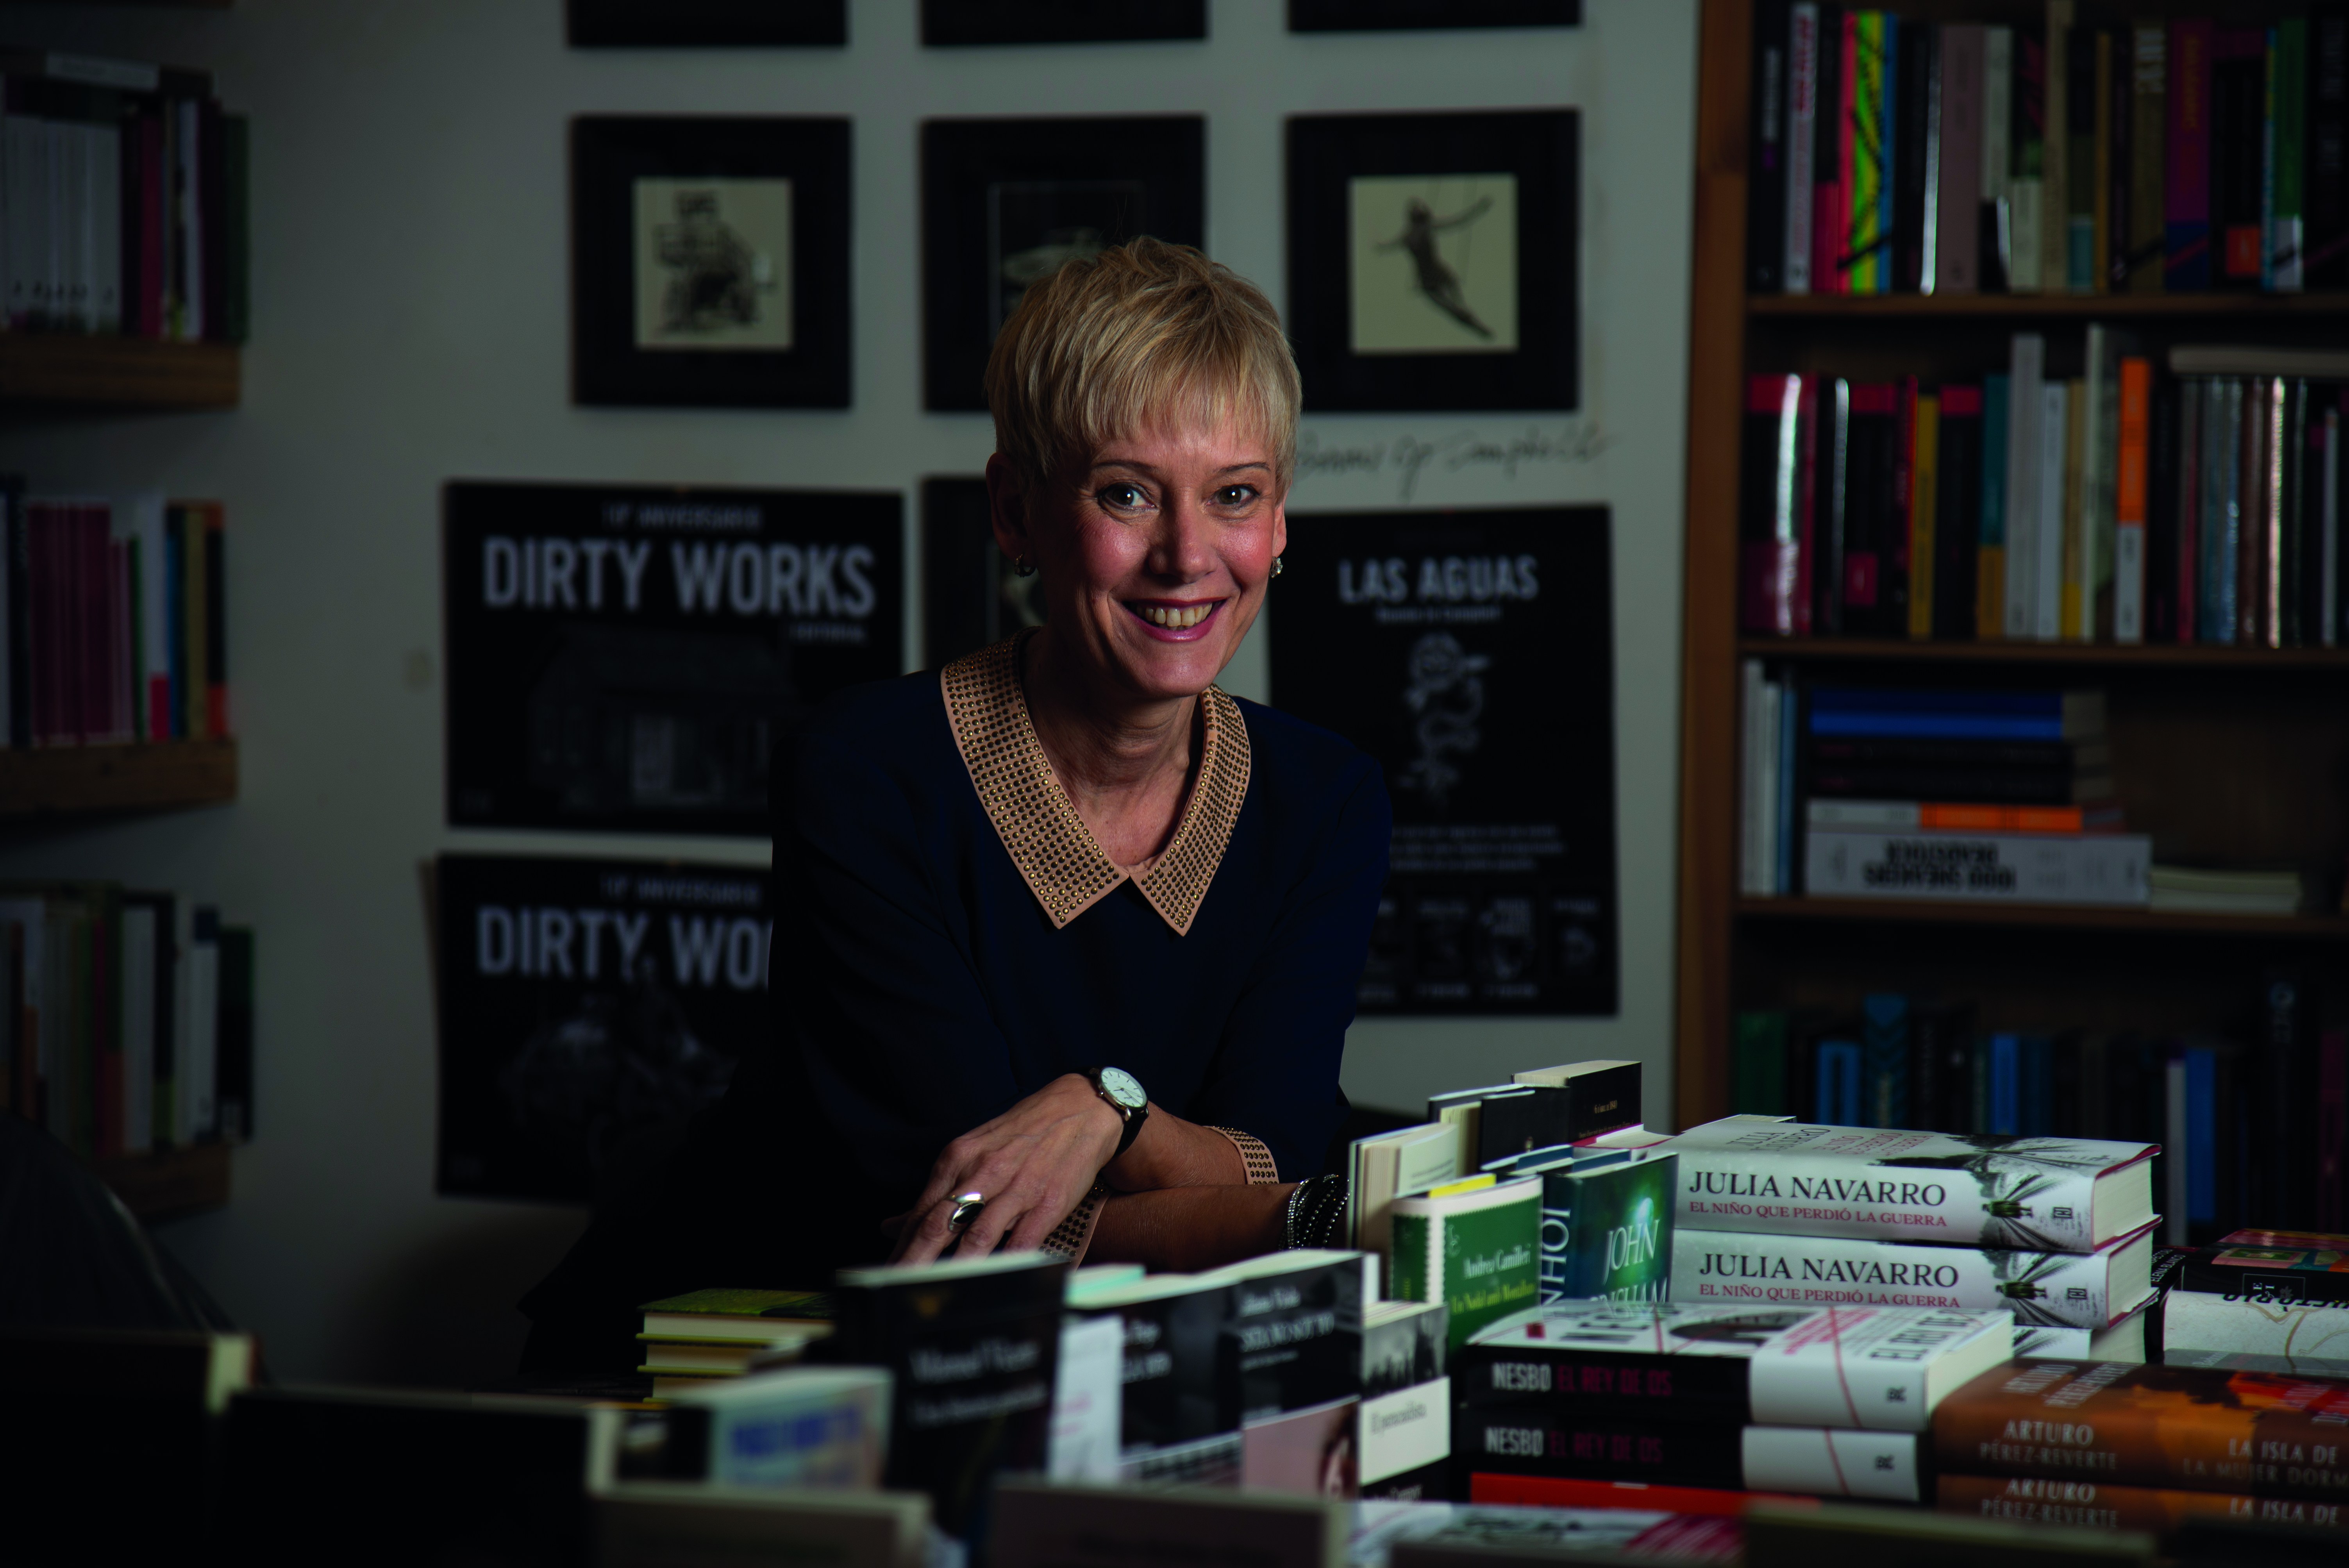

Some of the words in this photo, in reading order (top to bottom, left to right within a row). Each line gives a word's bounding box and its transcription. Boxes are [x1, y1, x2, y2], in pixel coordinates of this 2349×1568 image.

[481, 534, 653, 613] DIRTY
[669, 539, 880, 620] WORKS
[1337, 555, 1409, 605] LAS
[1416, 553, 1540, 603] AGUAS
[475, 904, 652, 985] DIRTY
[1689, 1171, 1783, 1198] JULIA
[1790, 1176, 1947, 1207] NAVARRO
[1689, 1201, 1707, 1213] EL
[1712, 1200, 1753, 1216] NIÑO
[1756, 1205, 1790, 1218] QUE
[1793, 1206, 1852, 1222] PERDIÓ
[1856, 1210, 1877, 1223] LA
[1881, 1212, 1947, 1227] GUERRA
[1463, 1253, 1495, 1280] Andrea
[1602, 1219, 1660, 1286] JOHN
[2160, 1254, 2186, 1269] BLANCO
[1700, 1252, 1794, 1280] JULIA
[1801, 1258, 1960, 1288] NAVARRO
[2151, 1268, 2170, 1282] ELENA
[1700, 1284, 1719, 1295] EL
[1722, 1283, 1763, 1299] NIÑO
[1767, 1288, 1801, 1301] QUE
[1804, 1289, 1864, 1304] PERDIÓ
[1868, 1293, 1888, 1305] LA
[1892, 1295, 1961, 1308] GUERRA
[1557, 1364, 1577, 1393] EL
[1581, 1366, 1615, 1394] REY
[1619, 1368, 1642, 1396] DE
[1647, 1369, 1673, 1397] OS
[1549, 1430, 1568, 1459] EL
[2002, 1418, 2095, 1449] ARTURO
[1979, 1438, 2119, 1471] PÉREZ-REVERTE
[2228, 1438, 2254, 1459] LA
[2260, 1440, 2304, 1463] ISLA
[2311, 1445, 2340, 1466] DE
[2183, 1457, 2208, 1477] LA
[2215, 1461, 2279, 1483] MUJER
[2005, 1478, 2097, 1505] ARTURO
[1981, 1495, 2119, 1528] PÉREZ-REVERTE
[2229, 1497, 2254, 1517] LA
[2262, 1500, 2305, 1523] ISLA
[2313, 1505, 2340, 1527] DE
